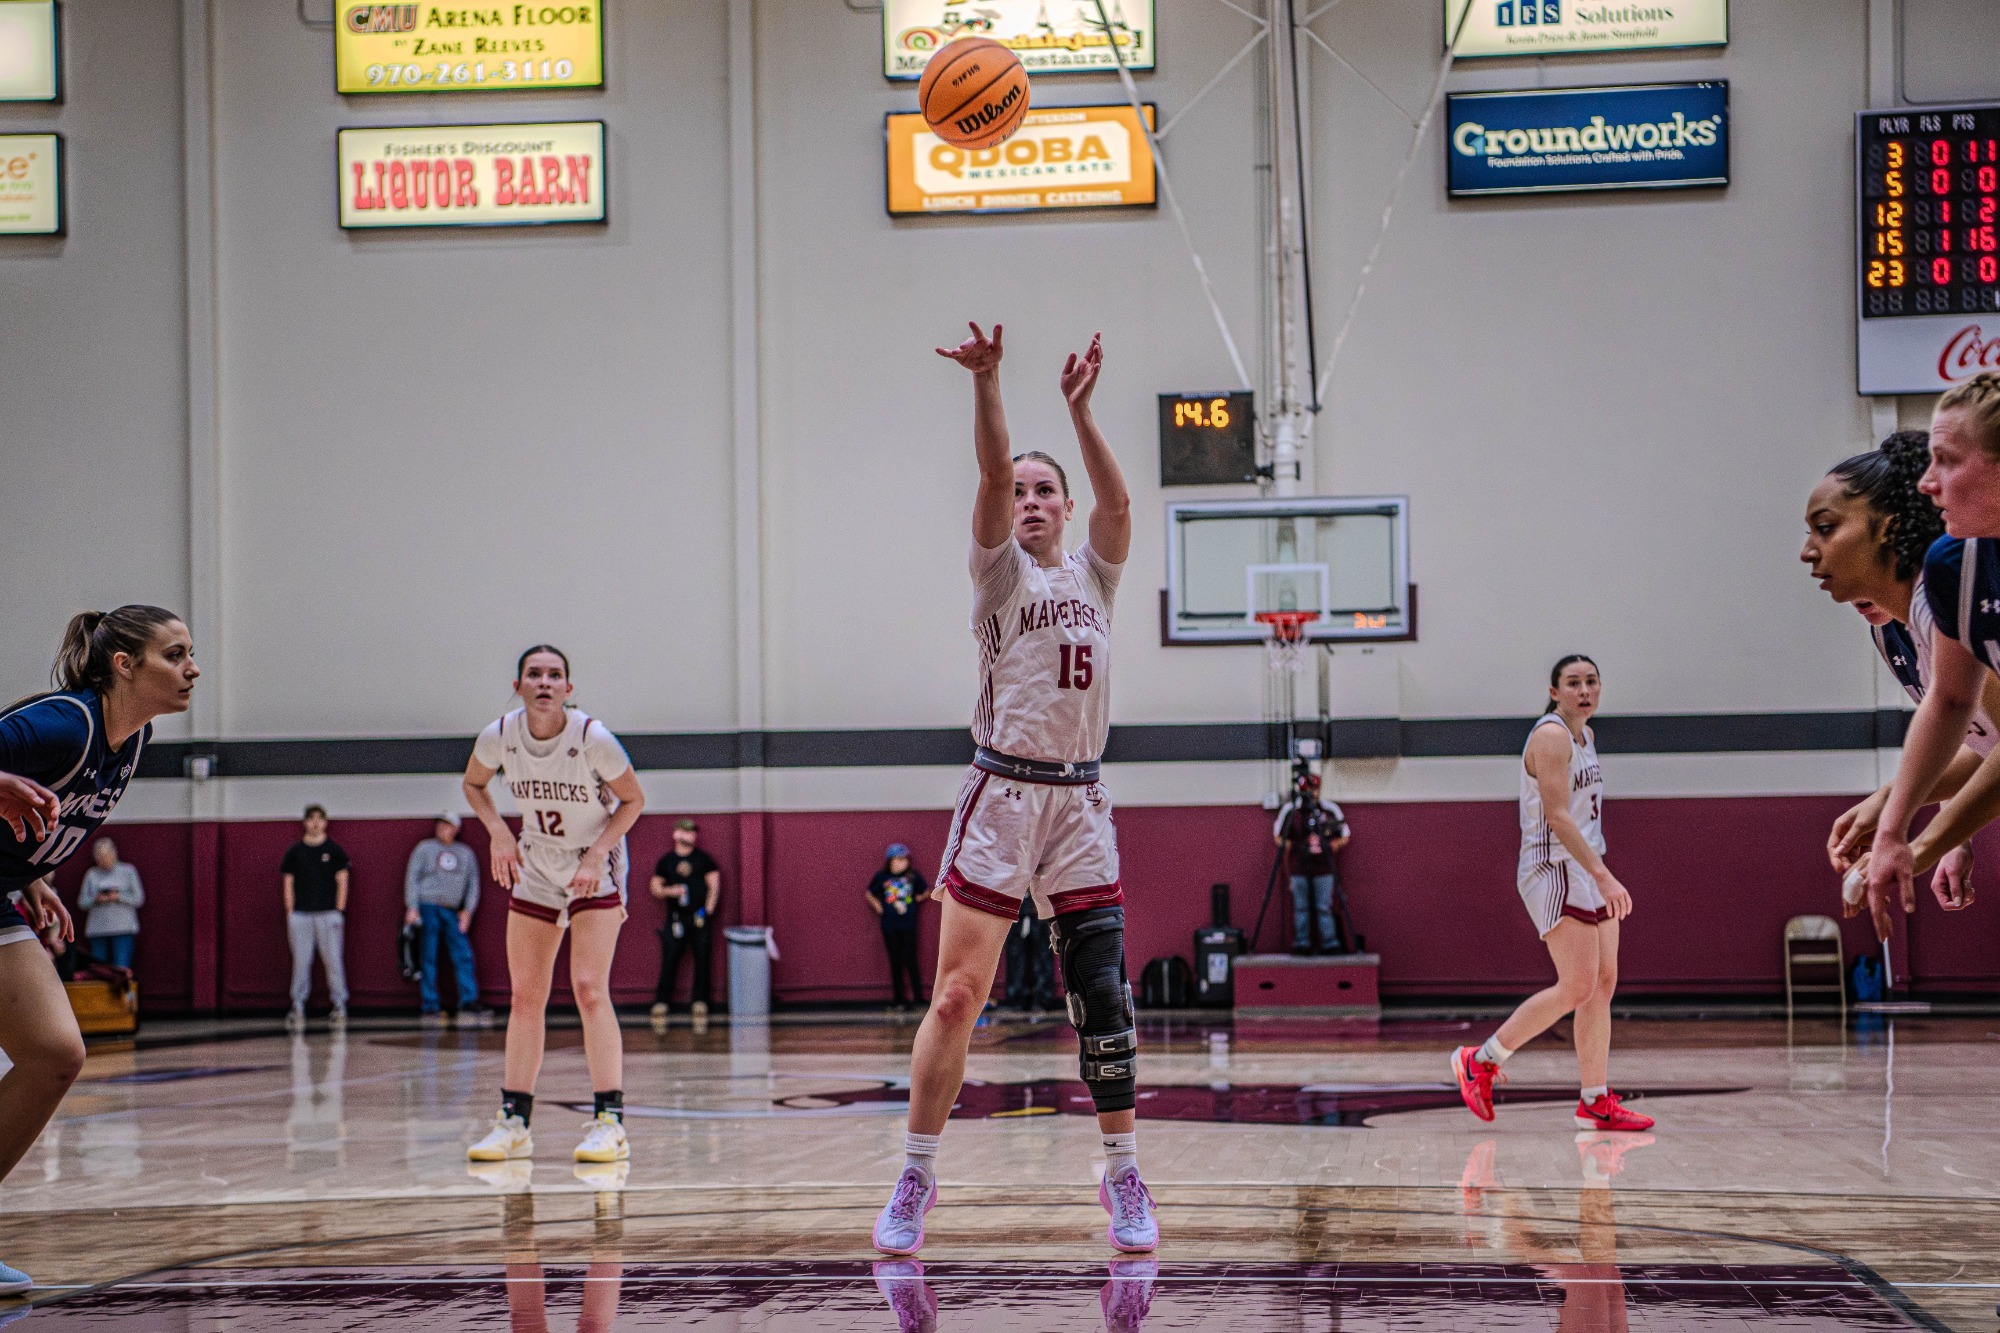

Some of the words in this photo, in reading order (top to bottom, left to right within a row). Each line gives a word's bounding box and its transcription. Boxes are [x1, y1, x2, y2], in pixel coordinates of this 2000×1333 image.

[347, 5, 417, 33] CMU
[514, 6, 592, 26] FLOOR
[1575, 4, 1674, 25] Solutions
[367, 59, 573, 86] 970-261-3110
[955, 84, 1021, 134] Wilson
[1920, 115, 1941, 132] FLS
[1952, 114, 1975, 130] PTS
[1453, 112, 1717, 156] Groundworks
[929, 135, 1111, 179] QDOBA
[1888, 142, 1903, 168] 3
[1932, 140, 1949, 166] 0
[1969, 139, 1996, 162] 11
[354, 158, 478, 210] LIQUOR
[495, 154, 590, 206] BARN
[1886, 170, 1903, 197] 5
[1932, 168, 1949, 194] 0
[1979, 166, 1996, 193] 0
[1877, 201, 1903, 228] 12
[1942, 200, 1950, 223] 1
[1979, 196, 1996, 223] 2
[1877, 229, 1903, 256] 15
[1942, 229, 1950, 251] 1
[1970, 226, 1997, 251] 16
[1868, 260, 1904, 287] 23
[1933, 258, 1950, 285] 0
[1979, 256, 1997, 283] 0
[1175, 399, 1230, 428] 14.6
[1058, 644, 1093, 690] 15
[535, 810, 565, 837] 12
